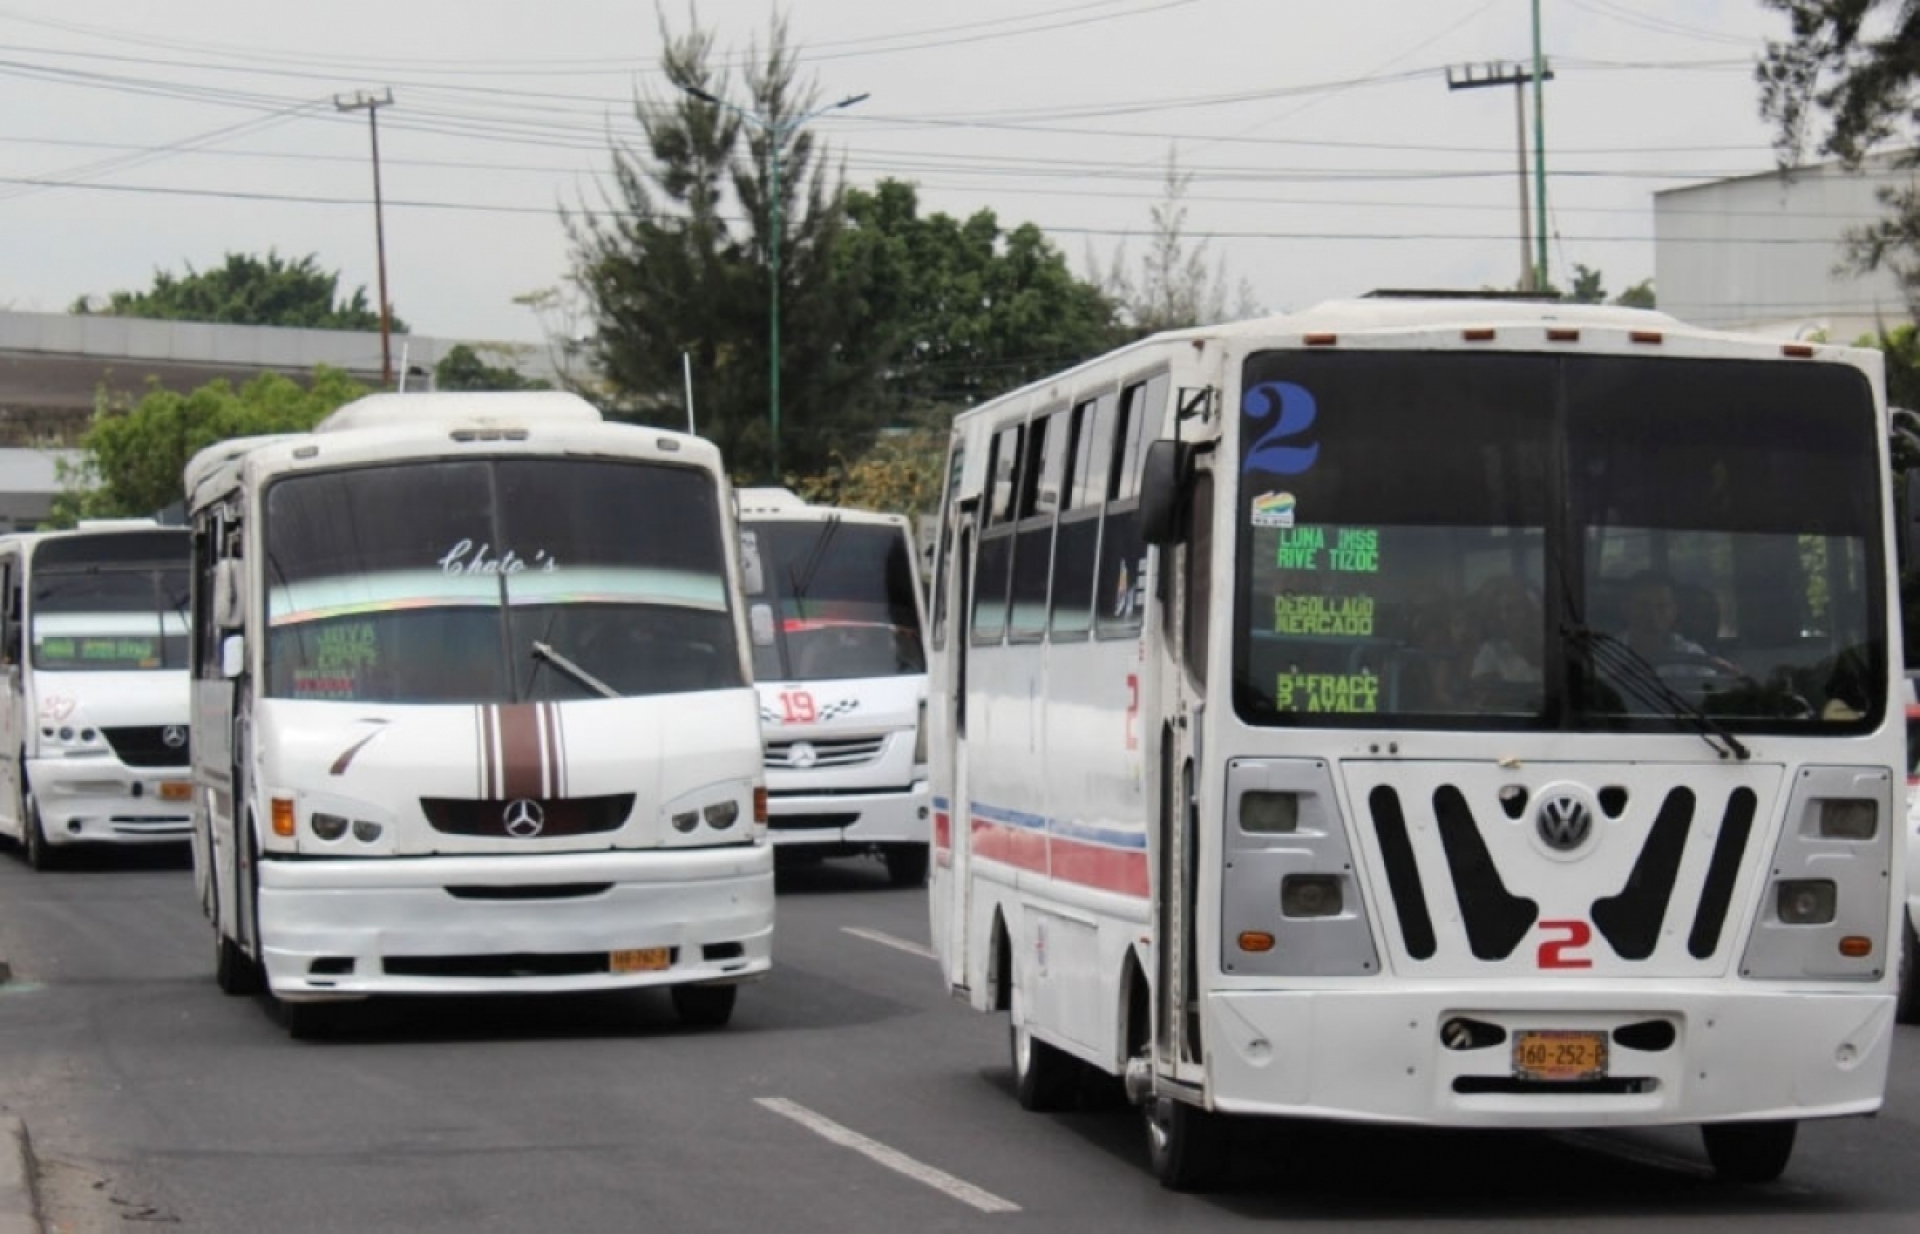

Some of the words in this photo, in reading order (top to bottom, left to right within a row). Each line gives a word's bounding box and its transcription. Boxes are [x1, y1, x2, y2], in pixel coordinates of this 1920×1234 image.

[1243, 381, 1319, 474] 2
[1280, 527, 1324, 549] LUNA
[1277, 549, 1317, 569] RIVE
[1328, 549, 1378, 570] TIZOC
[1275, 616, 1372, 635] MERCADO
[779, 691, 816, 724] 19
[328, 716, 392, 777] 7
[1538, 919, 1592, 969] 2
